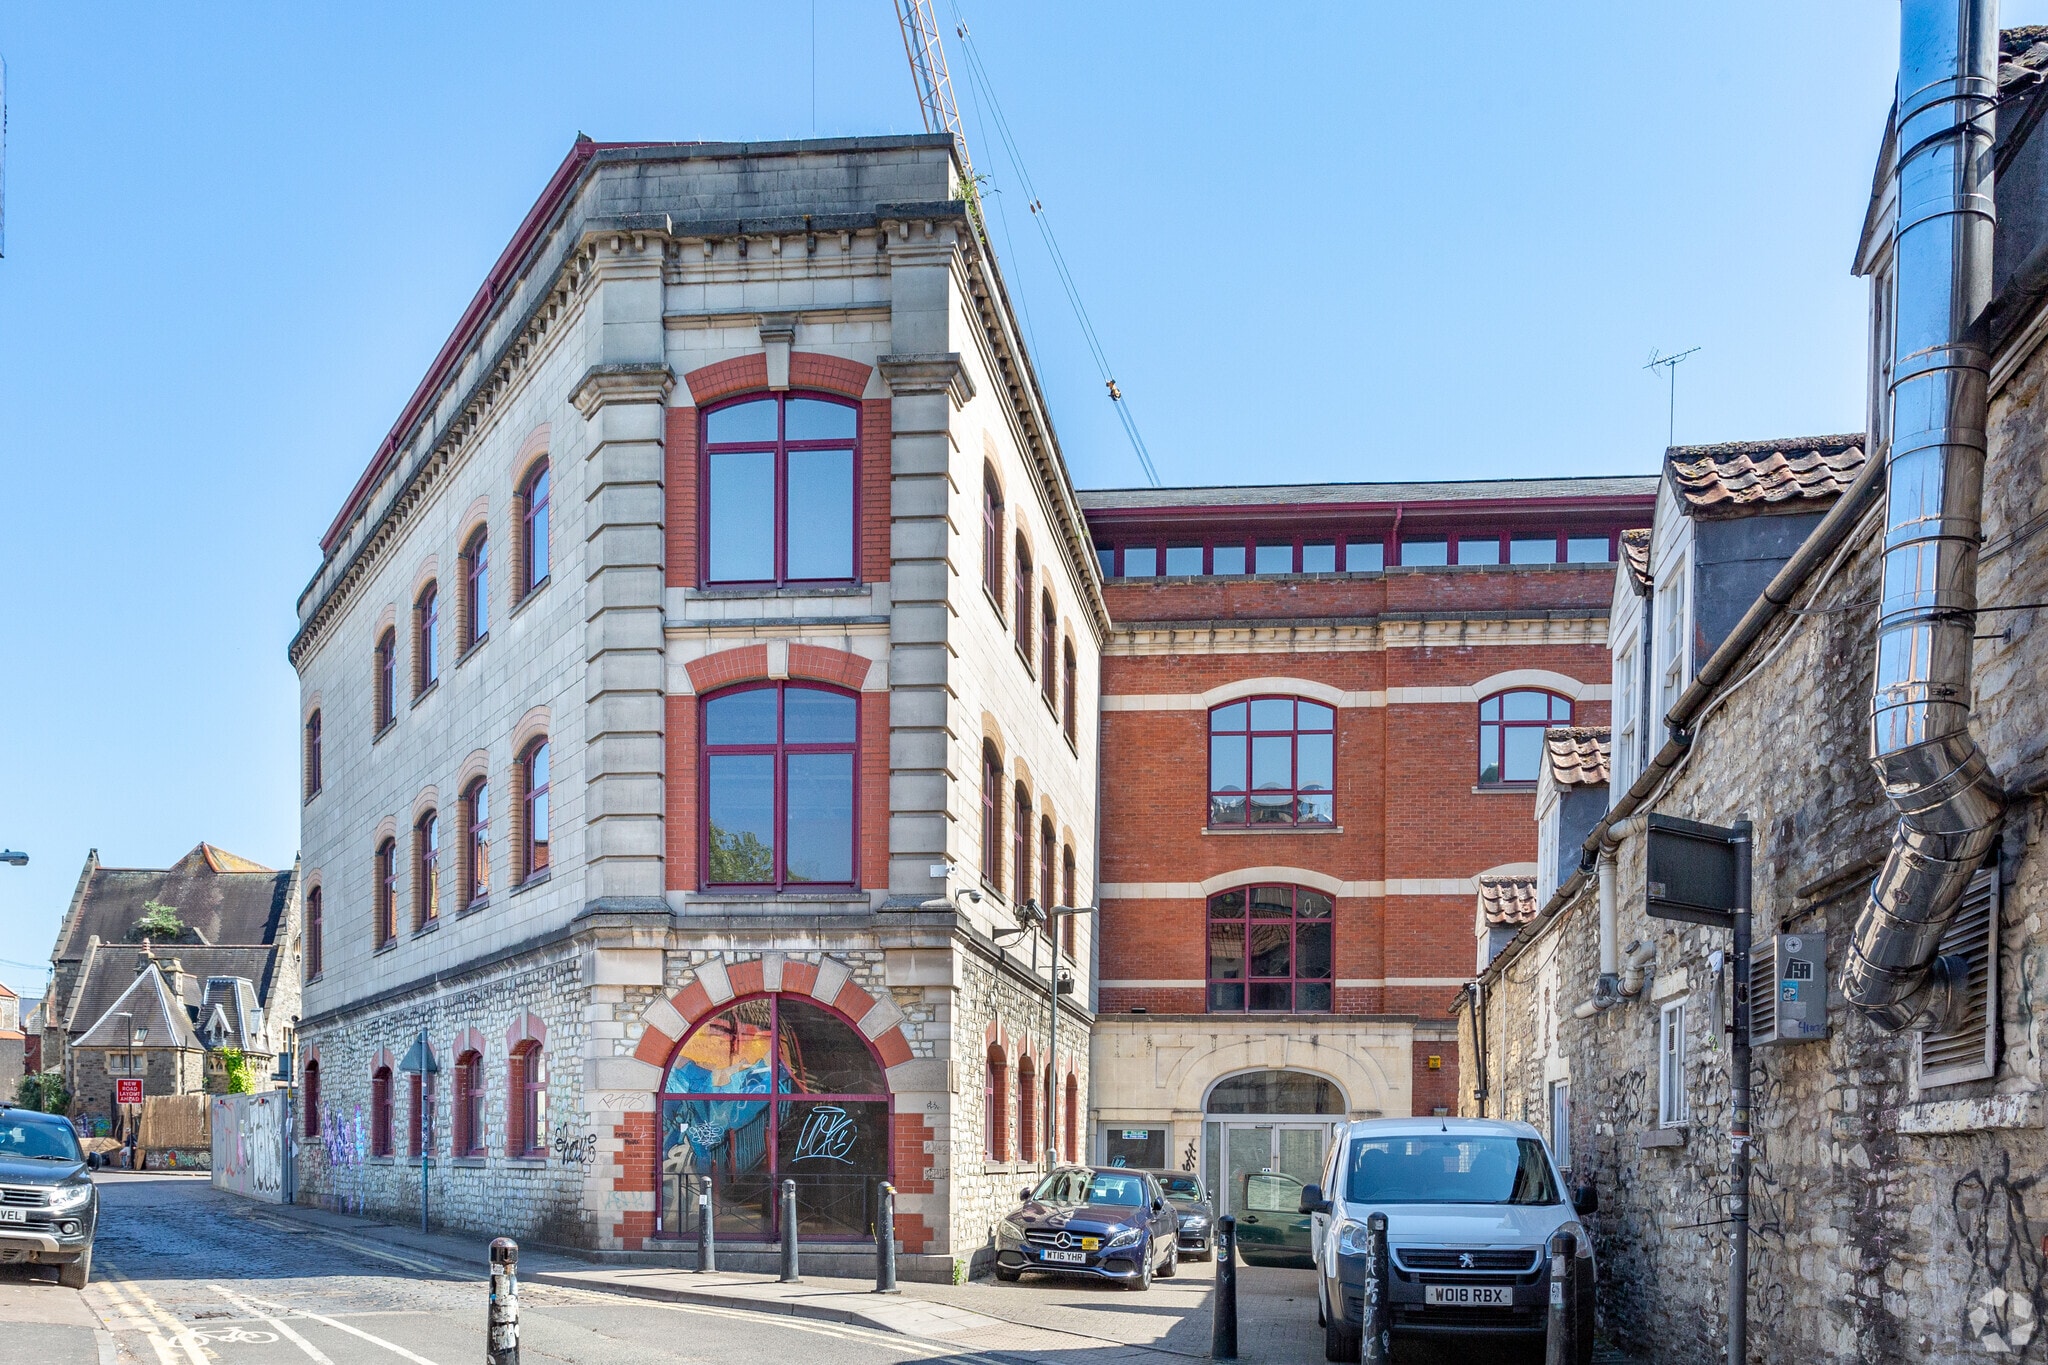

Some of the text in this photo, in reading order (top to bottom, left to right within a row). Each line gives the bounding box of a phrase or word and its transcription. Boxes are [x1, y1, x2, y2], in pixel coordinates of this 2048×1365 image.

[0, 1209, 22, 1221] VEL
[1047, 1250, 1083, 1262] WT16 YHR
[1435, 1287, 1503, 1303] WO18 RBX
